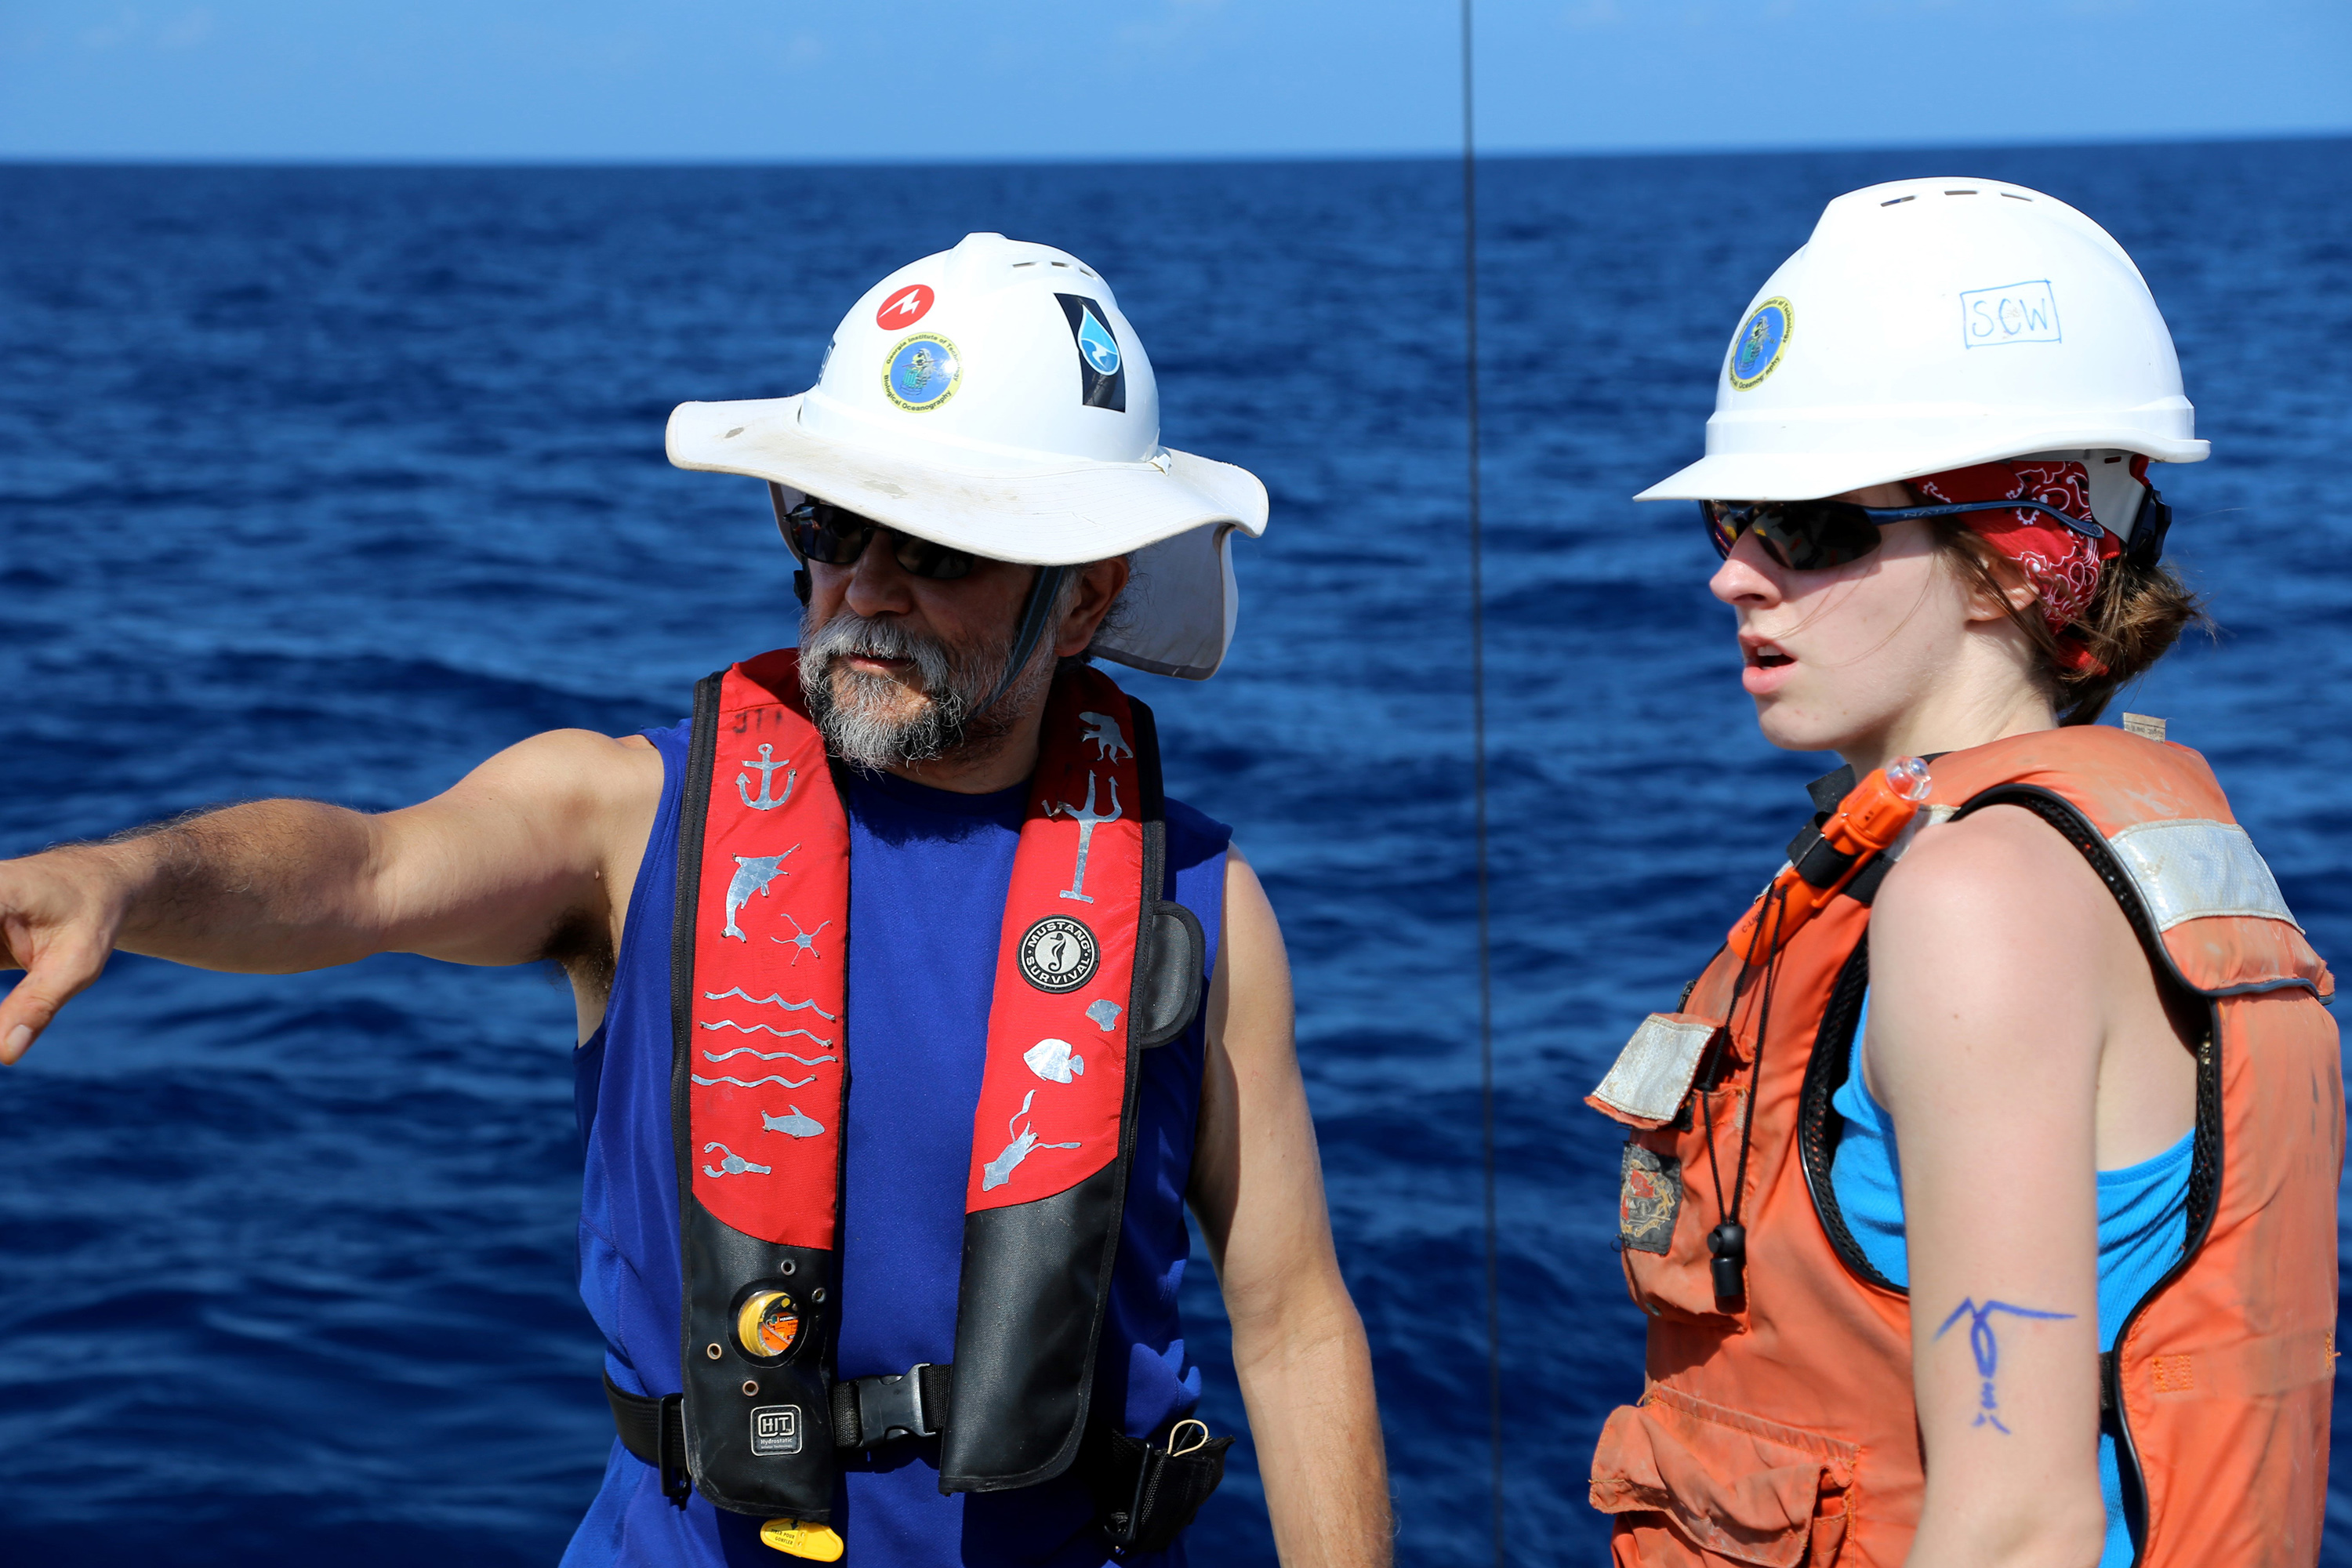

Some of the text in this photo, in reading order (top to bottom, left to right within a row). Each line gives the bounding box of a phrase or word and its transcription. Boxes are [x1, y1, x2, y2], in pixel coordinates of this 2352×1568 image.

[1783, 303, 1793, 343] Technology
[1972, 298, 2048, 337] SCW
[887, 342, 907, 365] Georgia
[908, 334, 938, 343] Institute
[1738, 355, 1780, 389] Oceanogaphy
[884, 375, 953, 411] Biological Oceanography
[1027, 922, 1090, 950] MUSTANG
[1026, 956, 1091, 984] SURVIVAL
[760, 1437, 793, 1446] Hydrostatic
[775, 1537, 793, 1545] GONFLER
